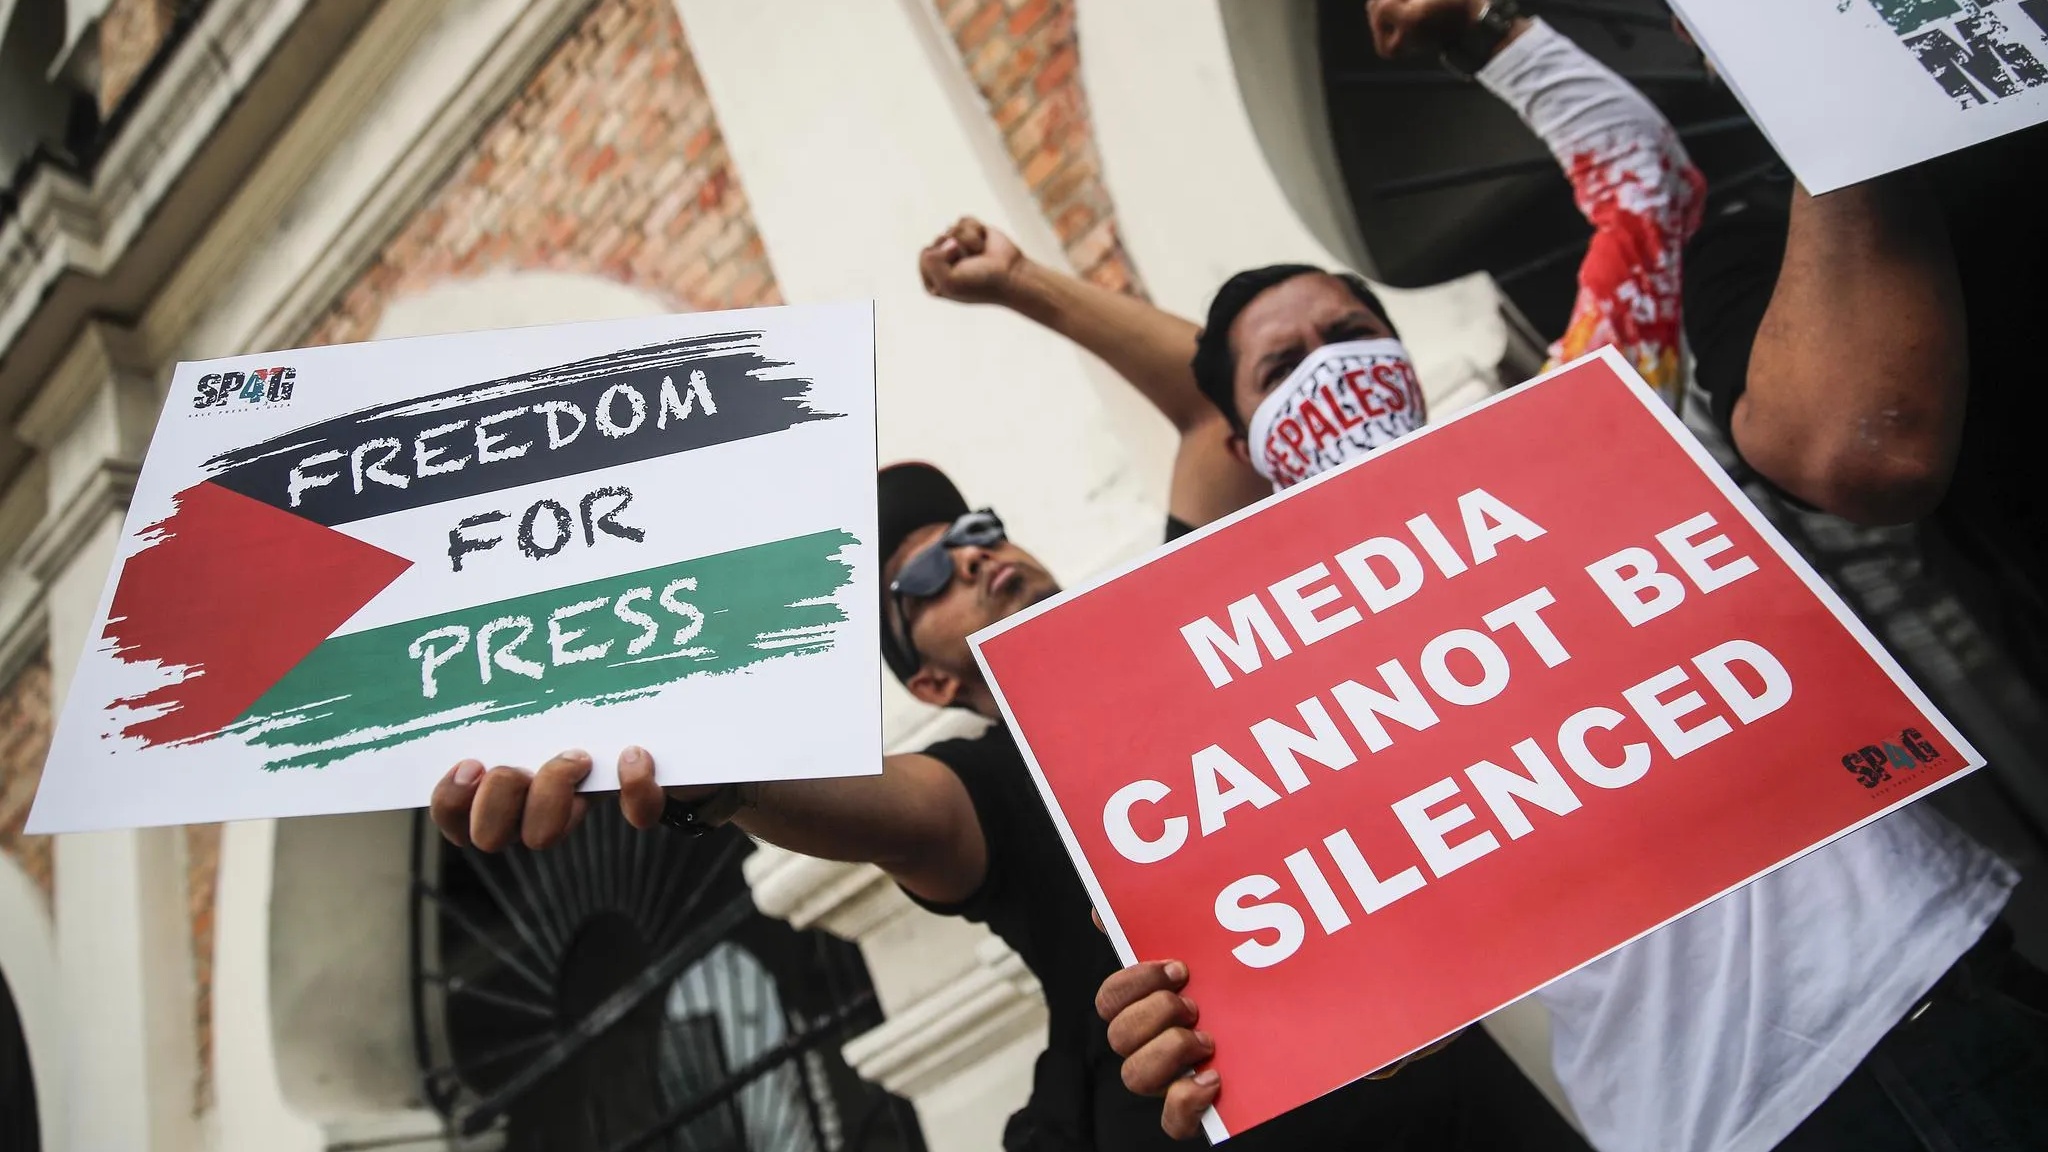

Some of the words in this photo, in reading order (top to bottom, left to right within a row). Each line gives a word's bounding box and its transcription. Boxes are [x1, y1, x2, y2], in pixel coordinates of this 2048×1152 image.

[194, 366, 297, 409] SP4G
[288, 370, 718, 507] FREEDOM
[448, 486, 646, 573] FOR
[1180, 488, 1548, 688] MEDIA
[408, 577, 705, 699] PRESS
[1103, 587, 1572, 864] CANNOT
[1585, 512, 1760, 628] BE
[1215, 640, 1793, 968] SILENCED
[1841, 728, 1940, 789] SP4G
